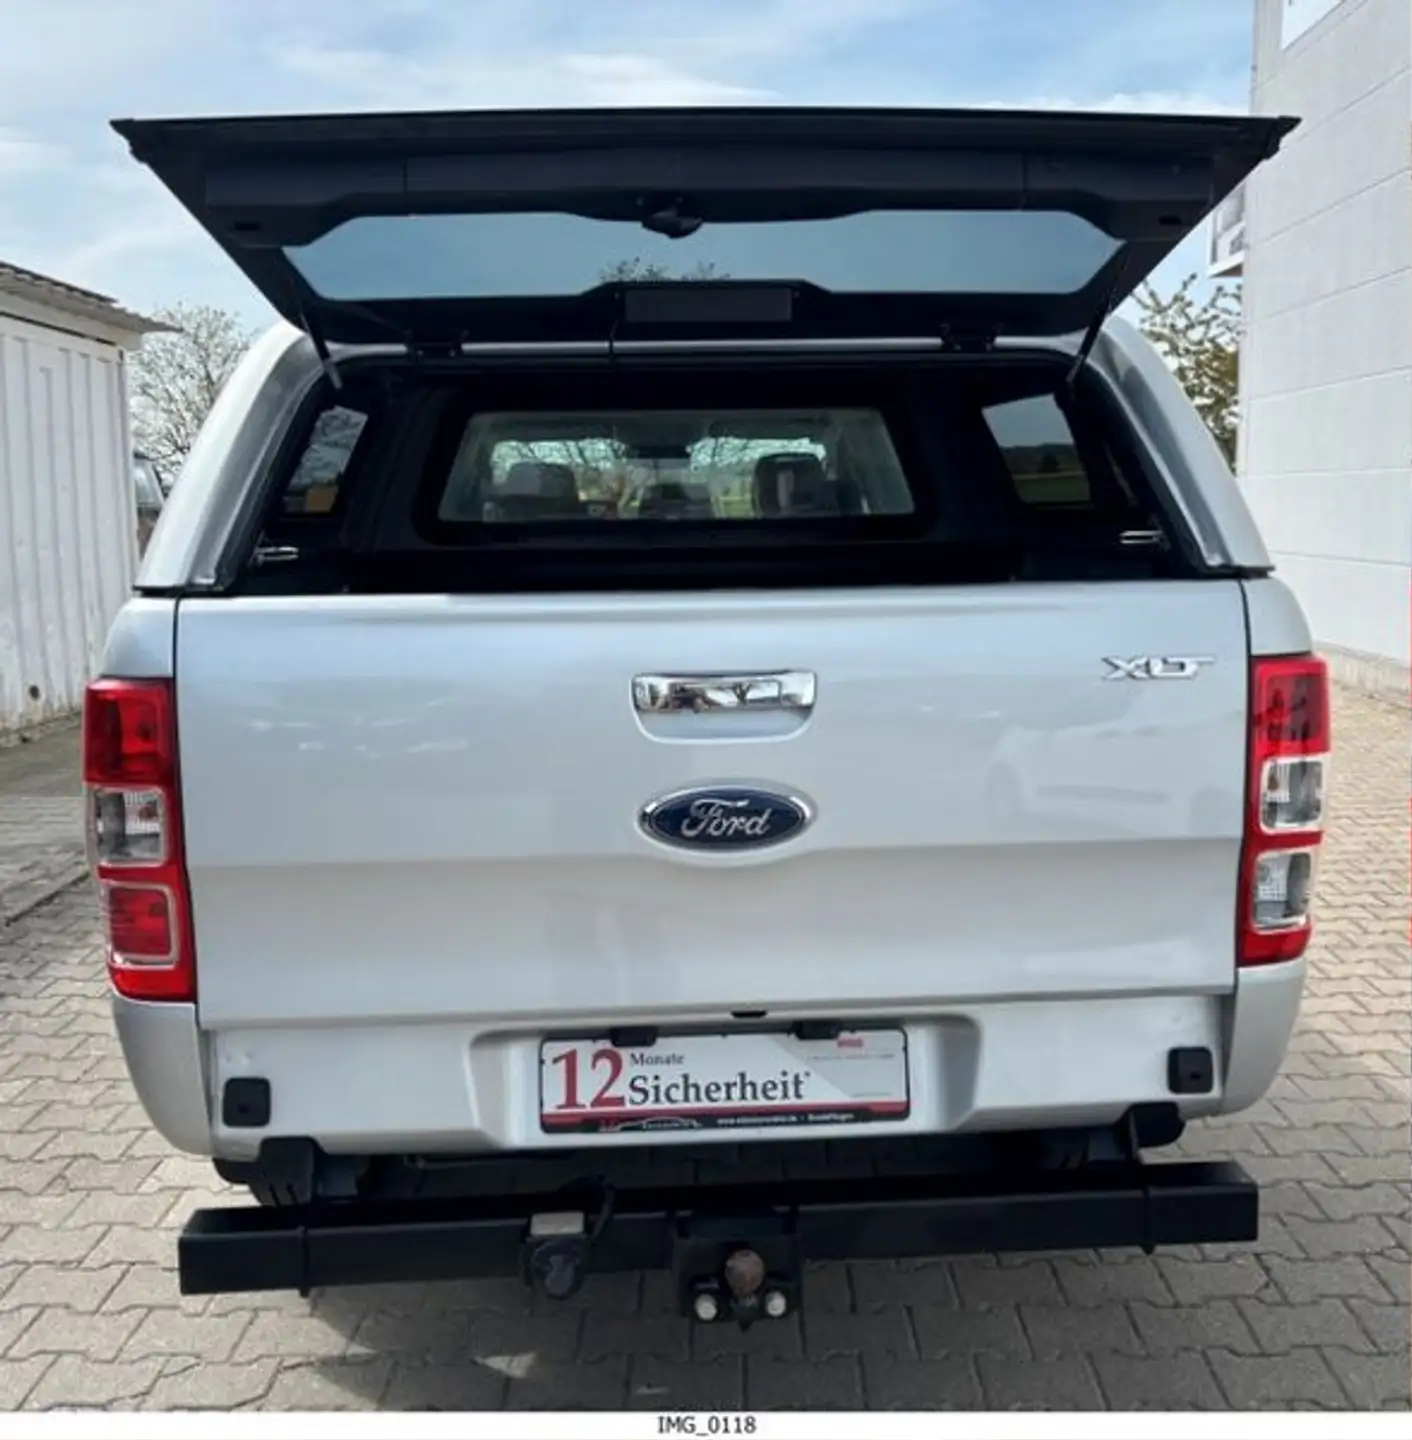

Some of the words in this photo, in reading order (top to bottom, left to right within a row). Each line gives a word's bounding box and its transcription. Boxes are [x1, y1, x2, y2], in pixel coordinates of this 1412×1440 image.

[1101, 656, 1215, 680] XLT
[682, 799, 772, 838] Ford
[629, 1052, 685, 1067] Monate
[552, 1048, 625, 1109] 12
